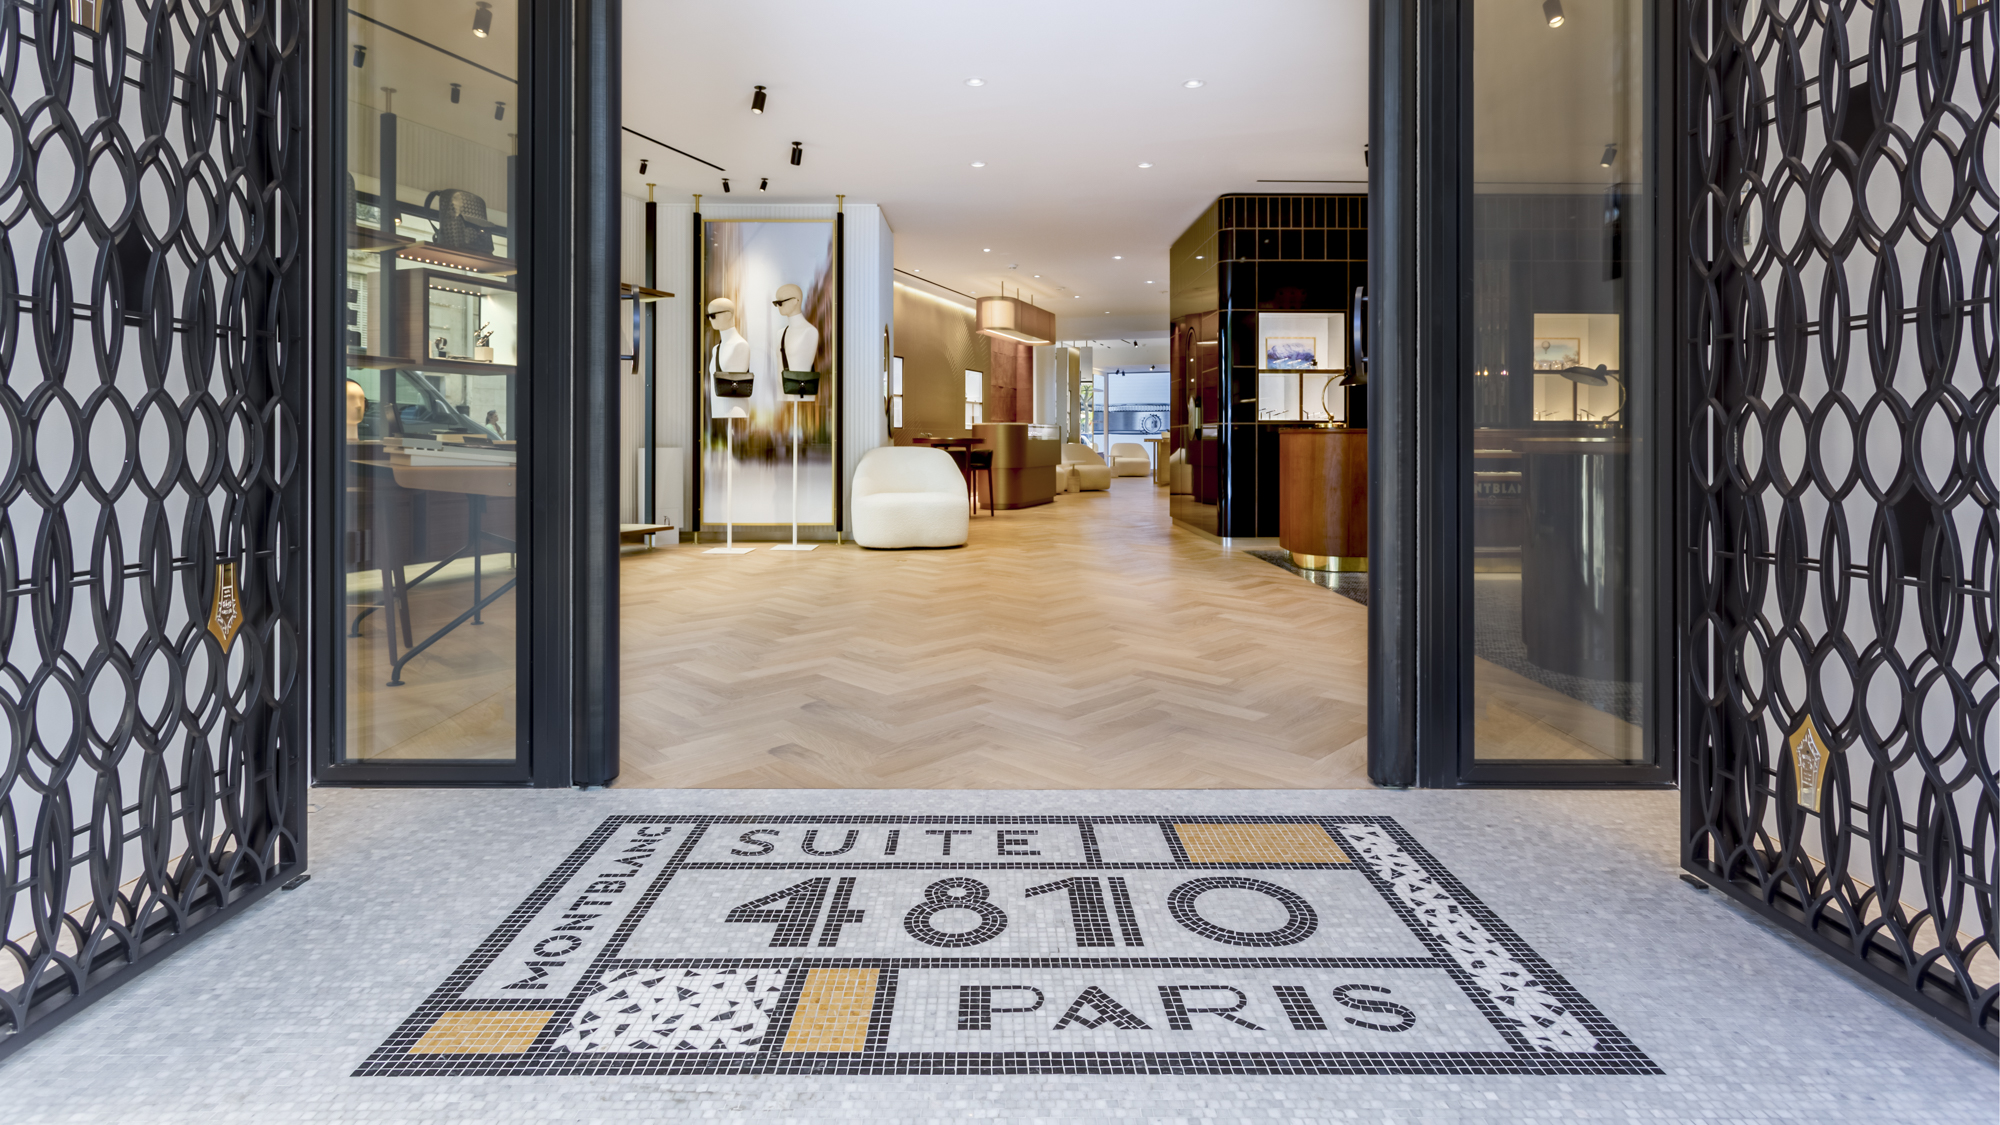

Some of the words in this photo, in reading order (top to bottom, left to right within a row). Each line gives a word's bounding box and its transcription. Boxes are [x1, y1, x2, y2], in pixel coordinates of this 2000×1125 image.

[730, 828, 1041, 857] SUITE
[500, 826, 672, 989] MONTBLANC
[725, 876, 1318, 948] 4810
[957, 984, 1417, 1033] PARIS
